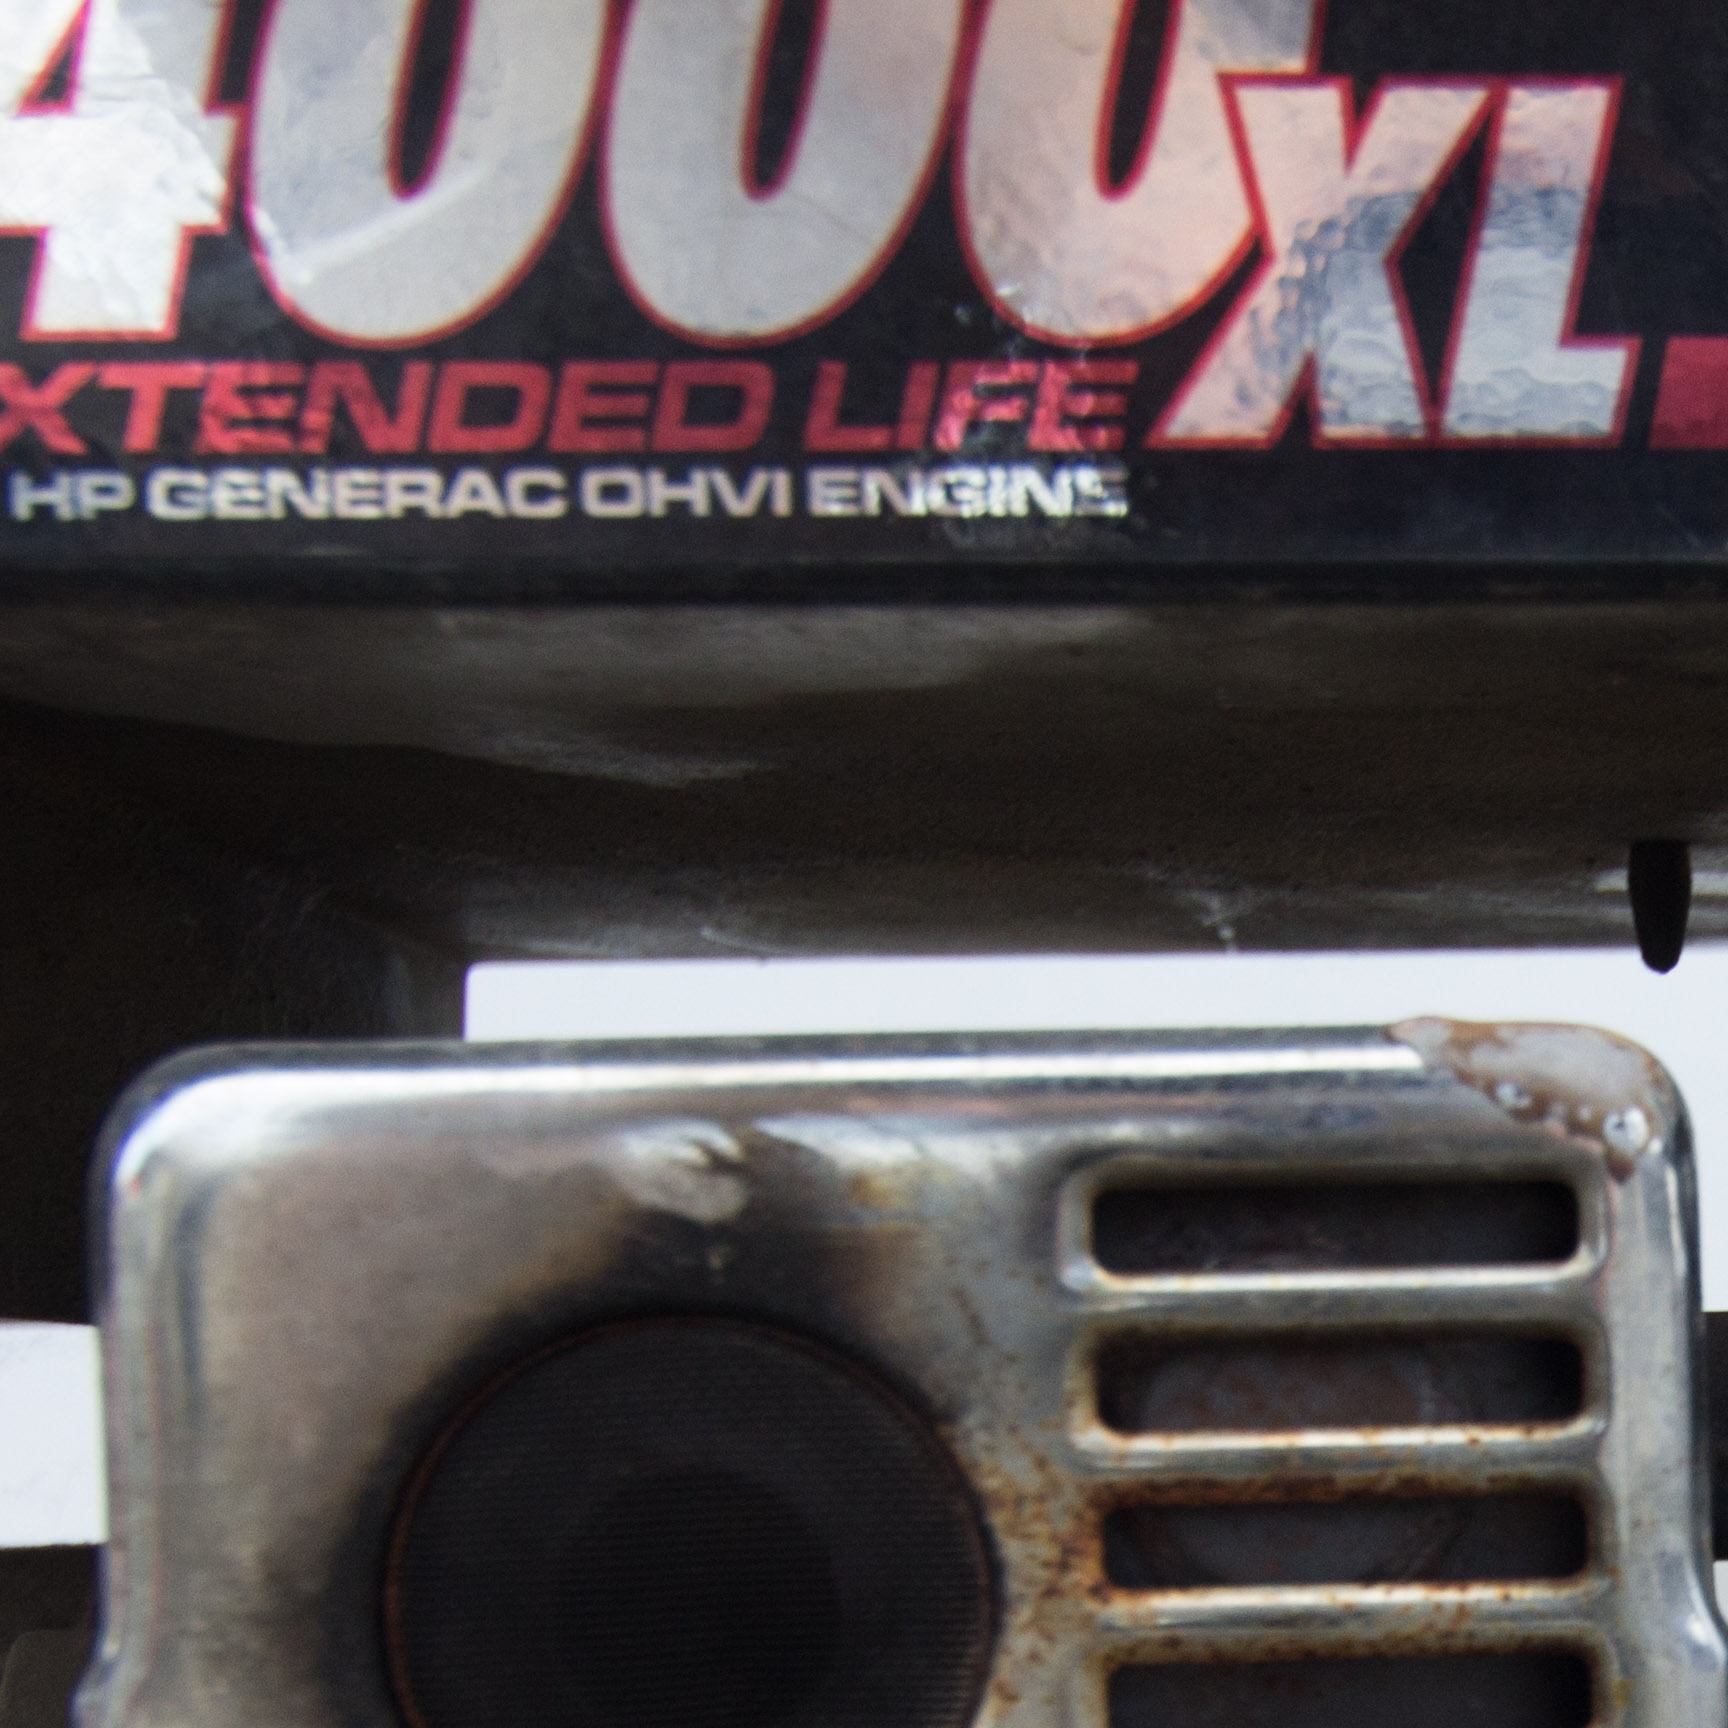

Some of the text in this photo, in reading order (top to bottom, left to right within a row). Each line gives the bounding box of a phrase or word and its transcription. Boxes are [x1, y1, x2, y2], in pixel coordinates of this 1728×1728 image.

[803, 359, 1140, 451] LIFE
[10, 466, 137, 522] HP
[146, 464, 568, 522] GENERAC
[580, 464, 793, 519] OHVI
